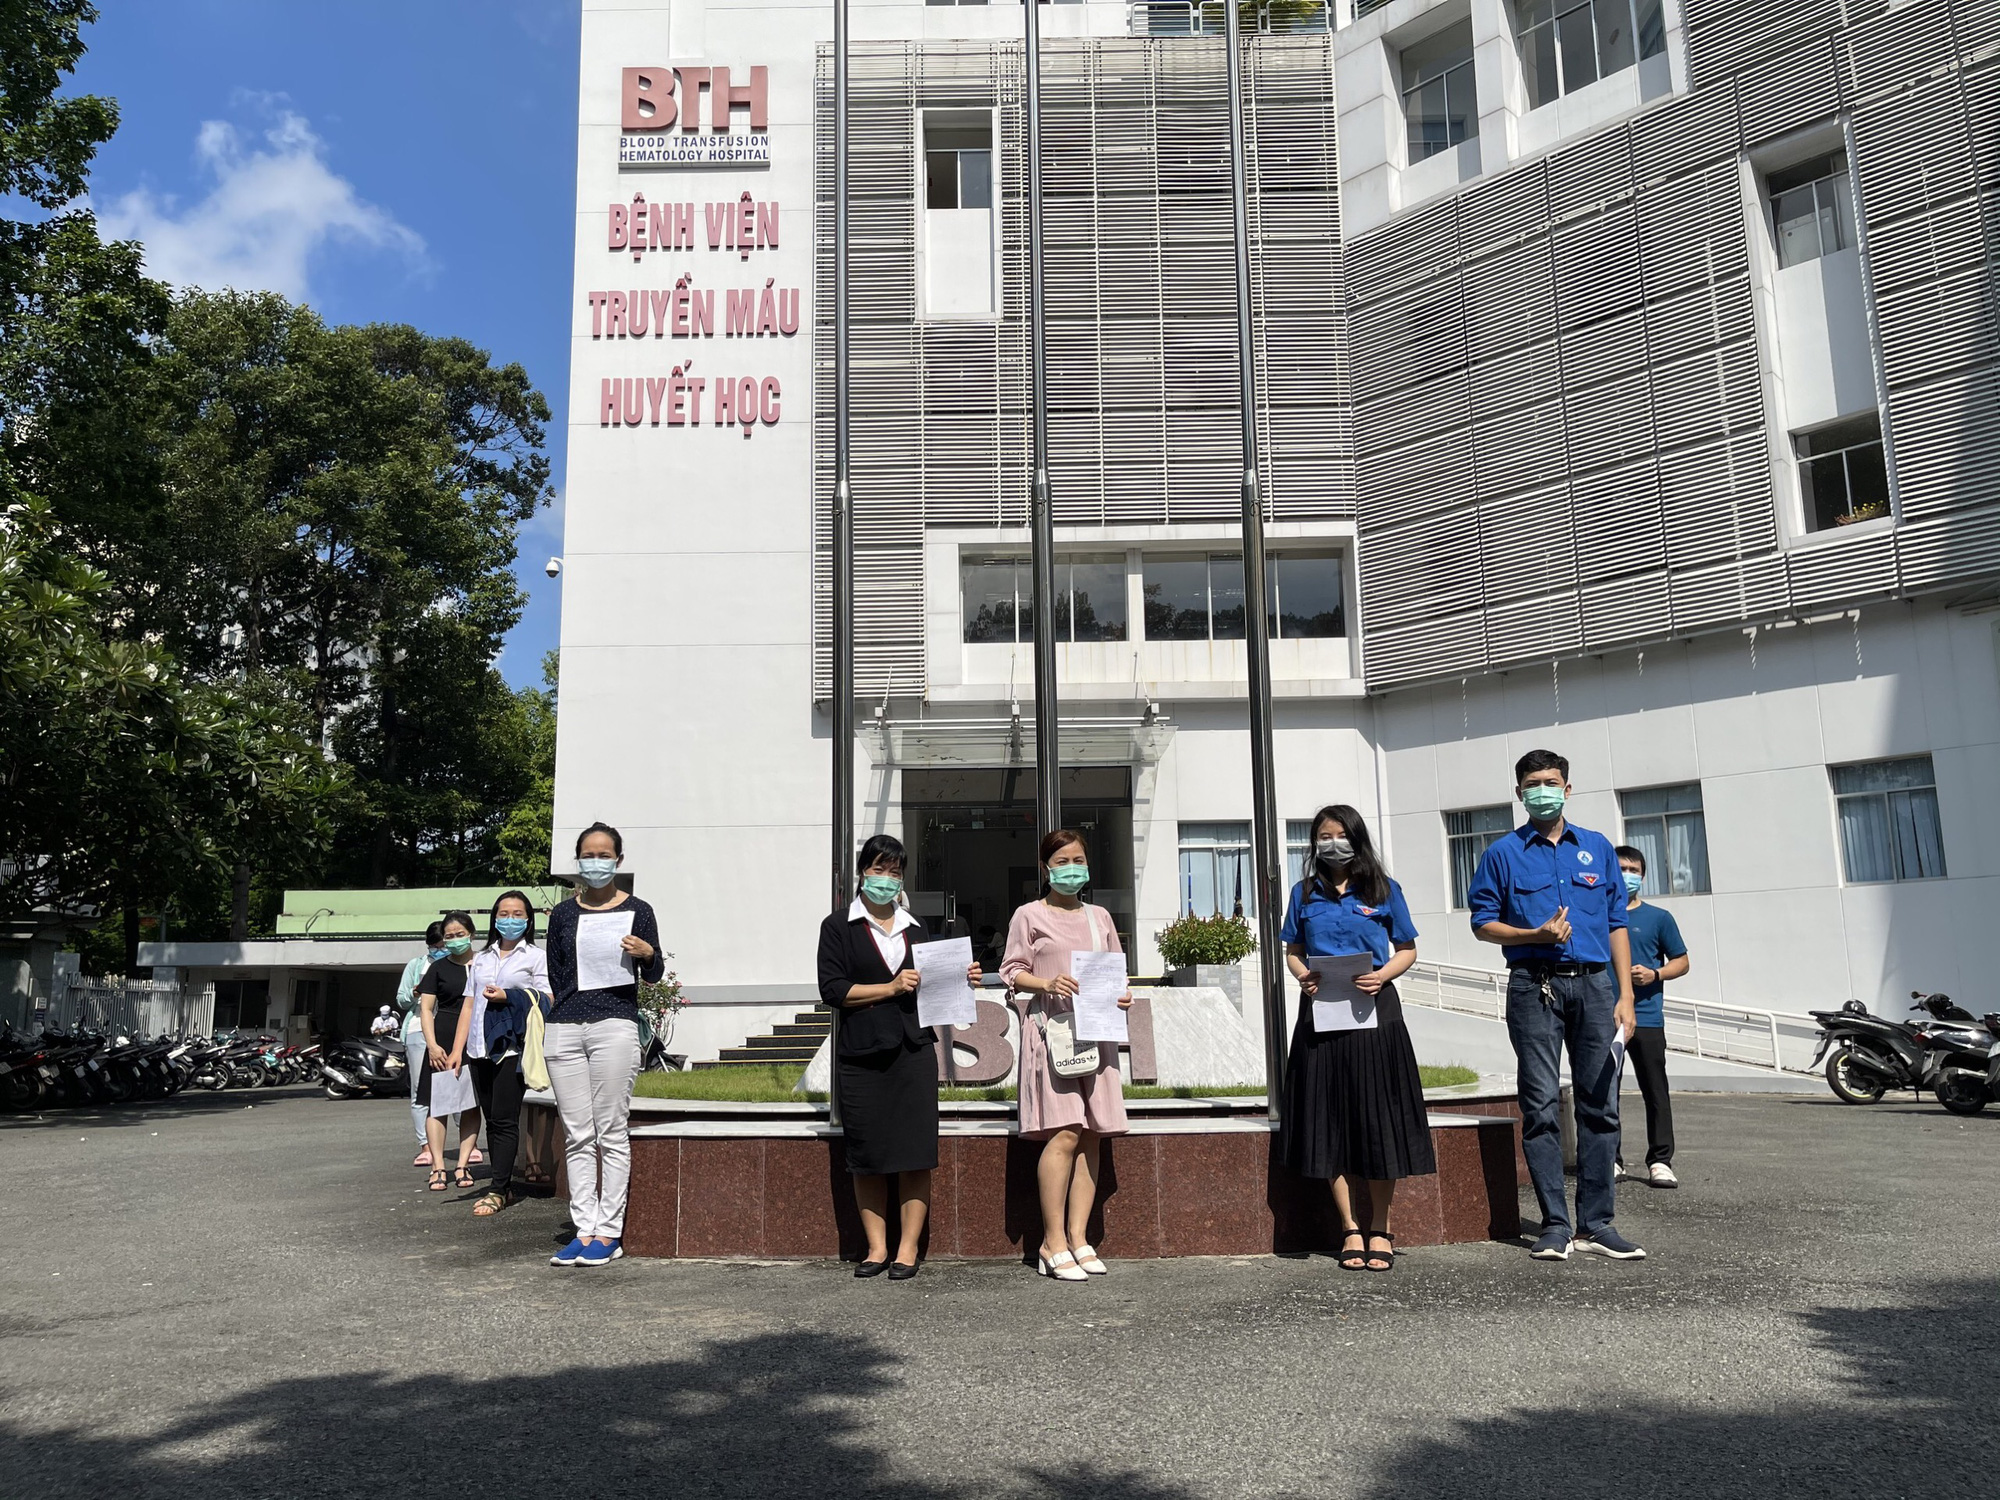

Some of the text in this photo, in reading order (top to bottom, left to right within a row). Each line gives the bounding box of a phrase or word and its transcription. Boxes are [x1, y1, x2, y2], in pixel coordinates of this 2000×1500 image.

[621, 65, 769, 132] BTH
[619, 149, 769, 161] HEMATOLOGY HOSPITAL
[620, 135, 769, 148] BLOOD TRANSFUSION
[608, 191, 779, 263] BỆNH VIỆN
[588, 272, 800, 340] TRUYỀN MÁU
[600, 359, 781, 439] HUYẾT HỌC
[1055, 1057, 1087, 1068] adidas
